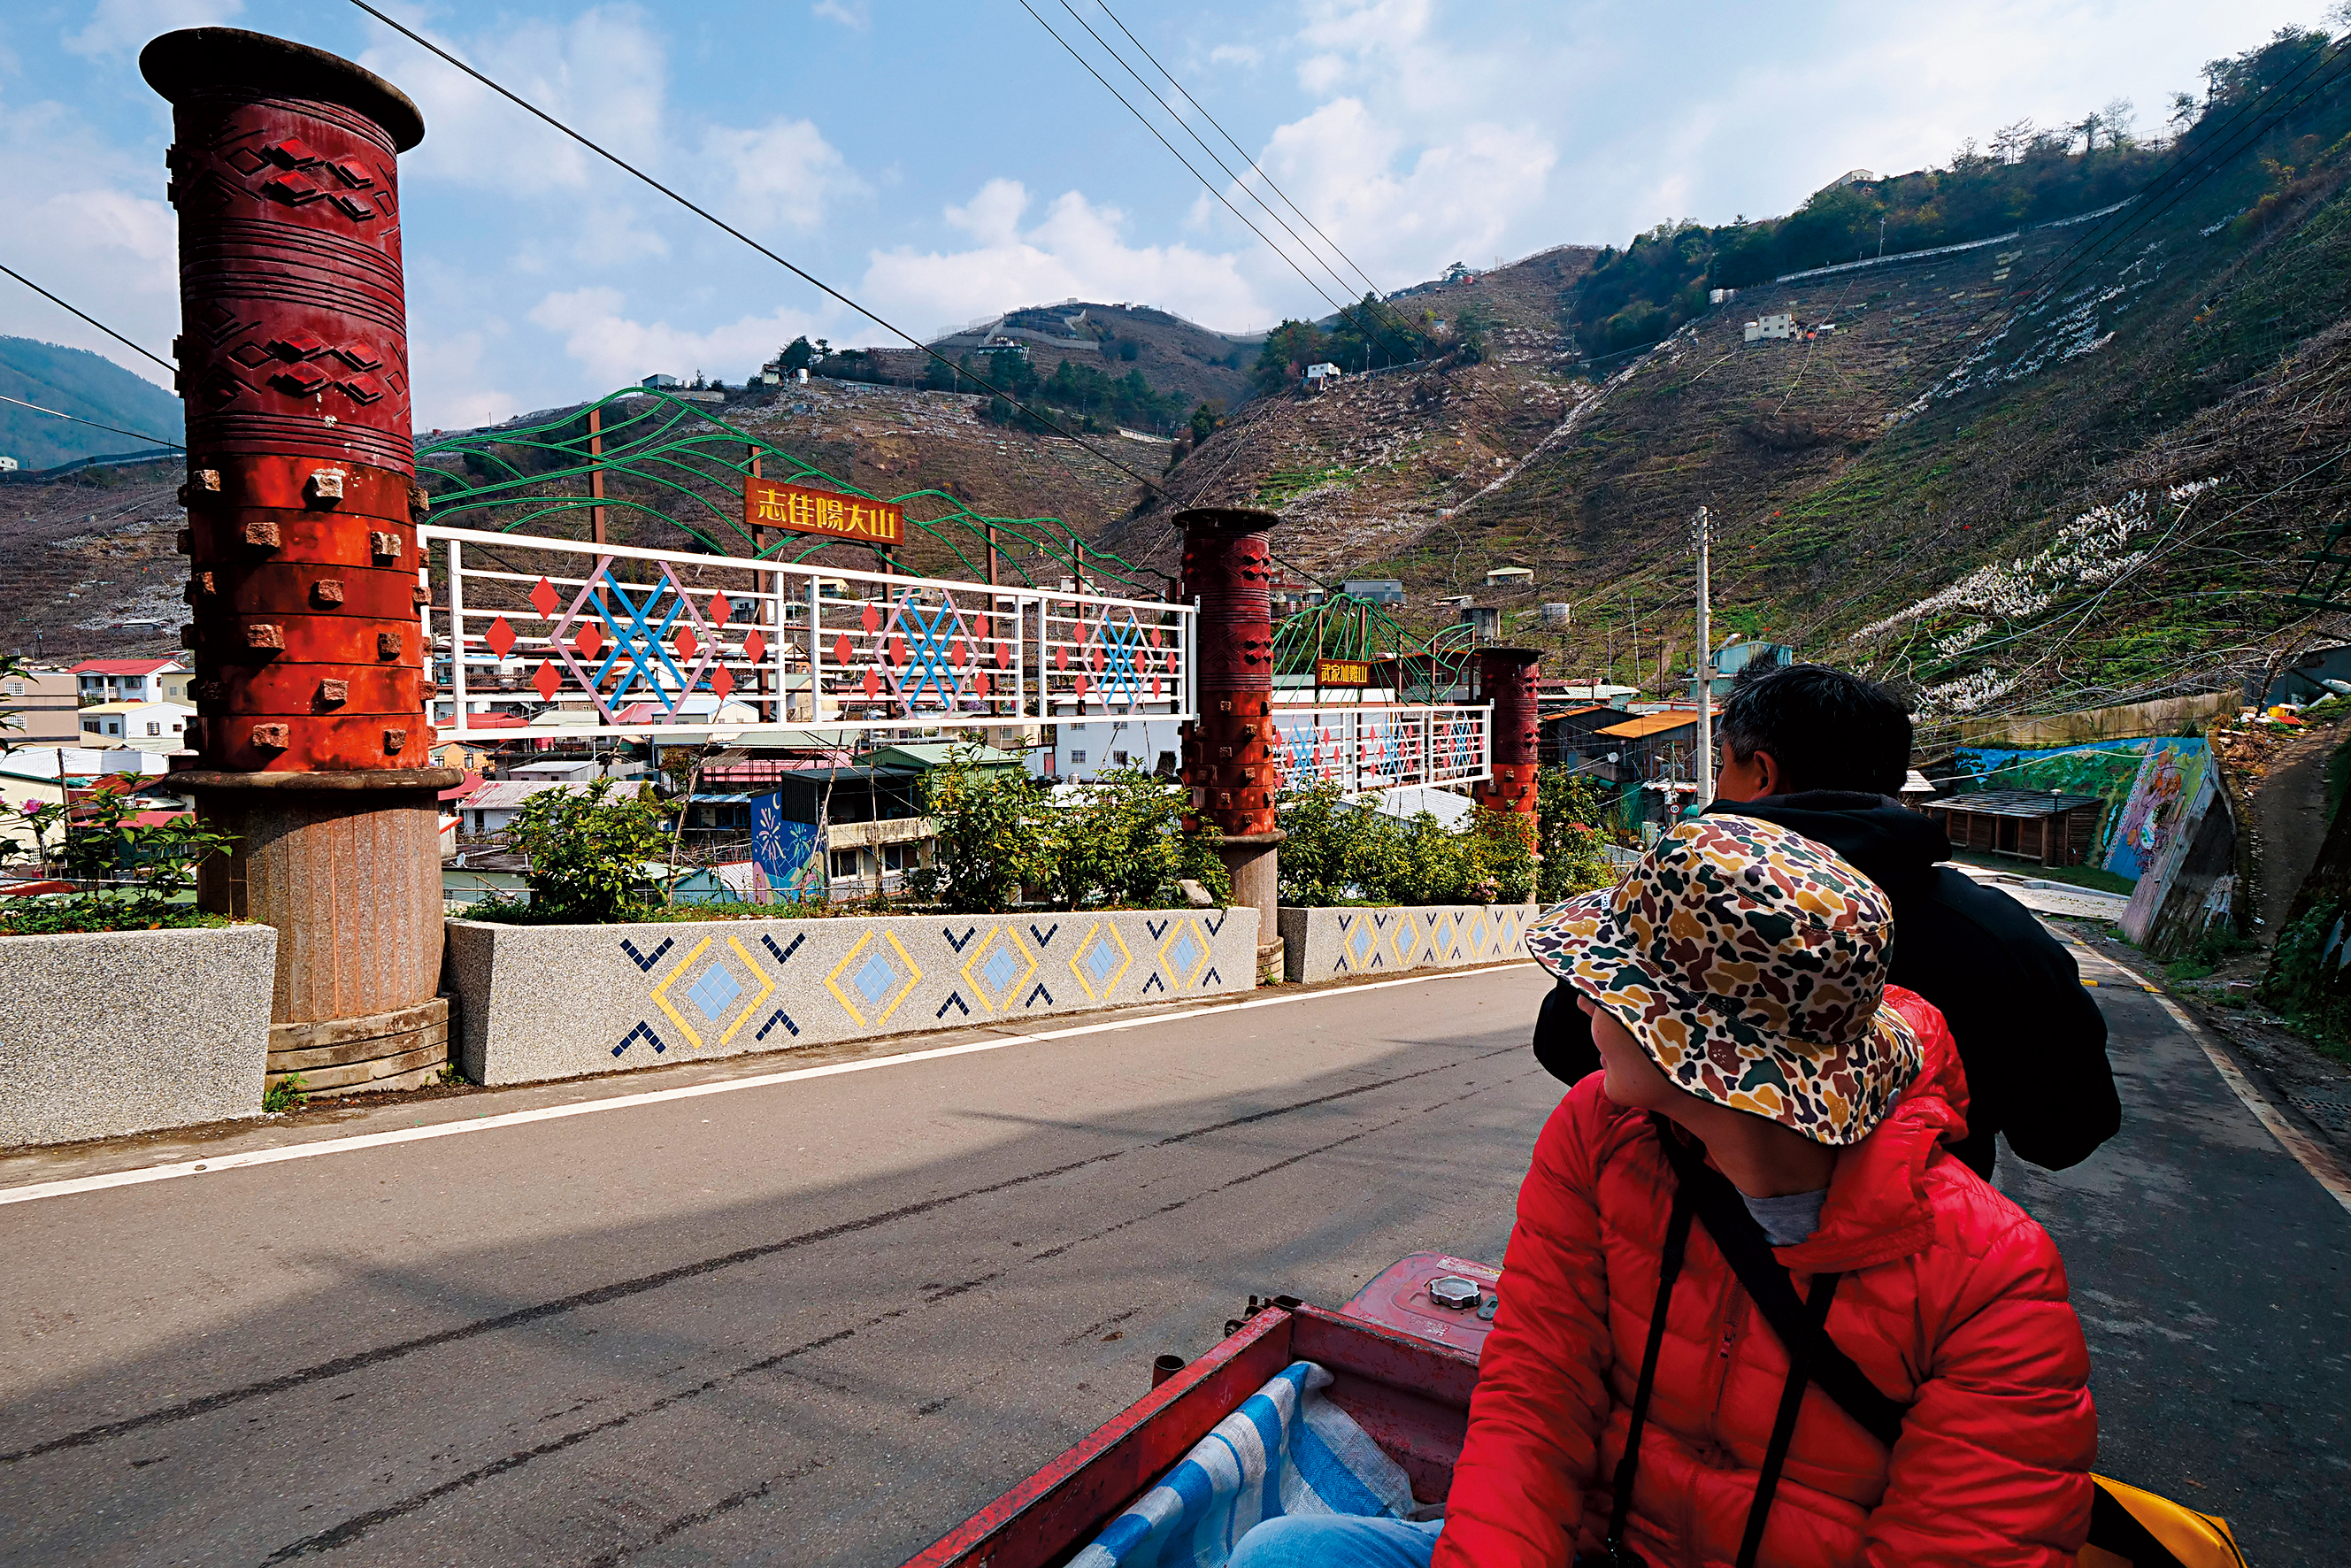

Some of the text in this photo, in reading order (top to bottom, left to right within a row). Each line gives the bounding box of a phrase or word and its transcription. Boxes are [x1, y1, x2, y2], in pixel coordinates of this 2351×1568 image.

[757, 488, 895, 538] 志佳陽大山
